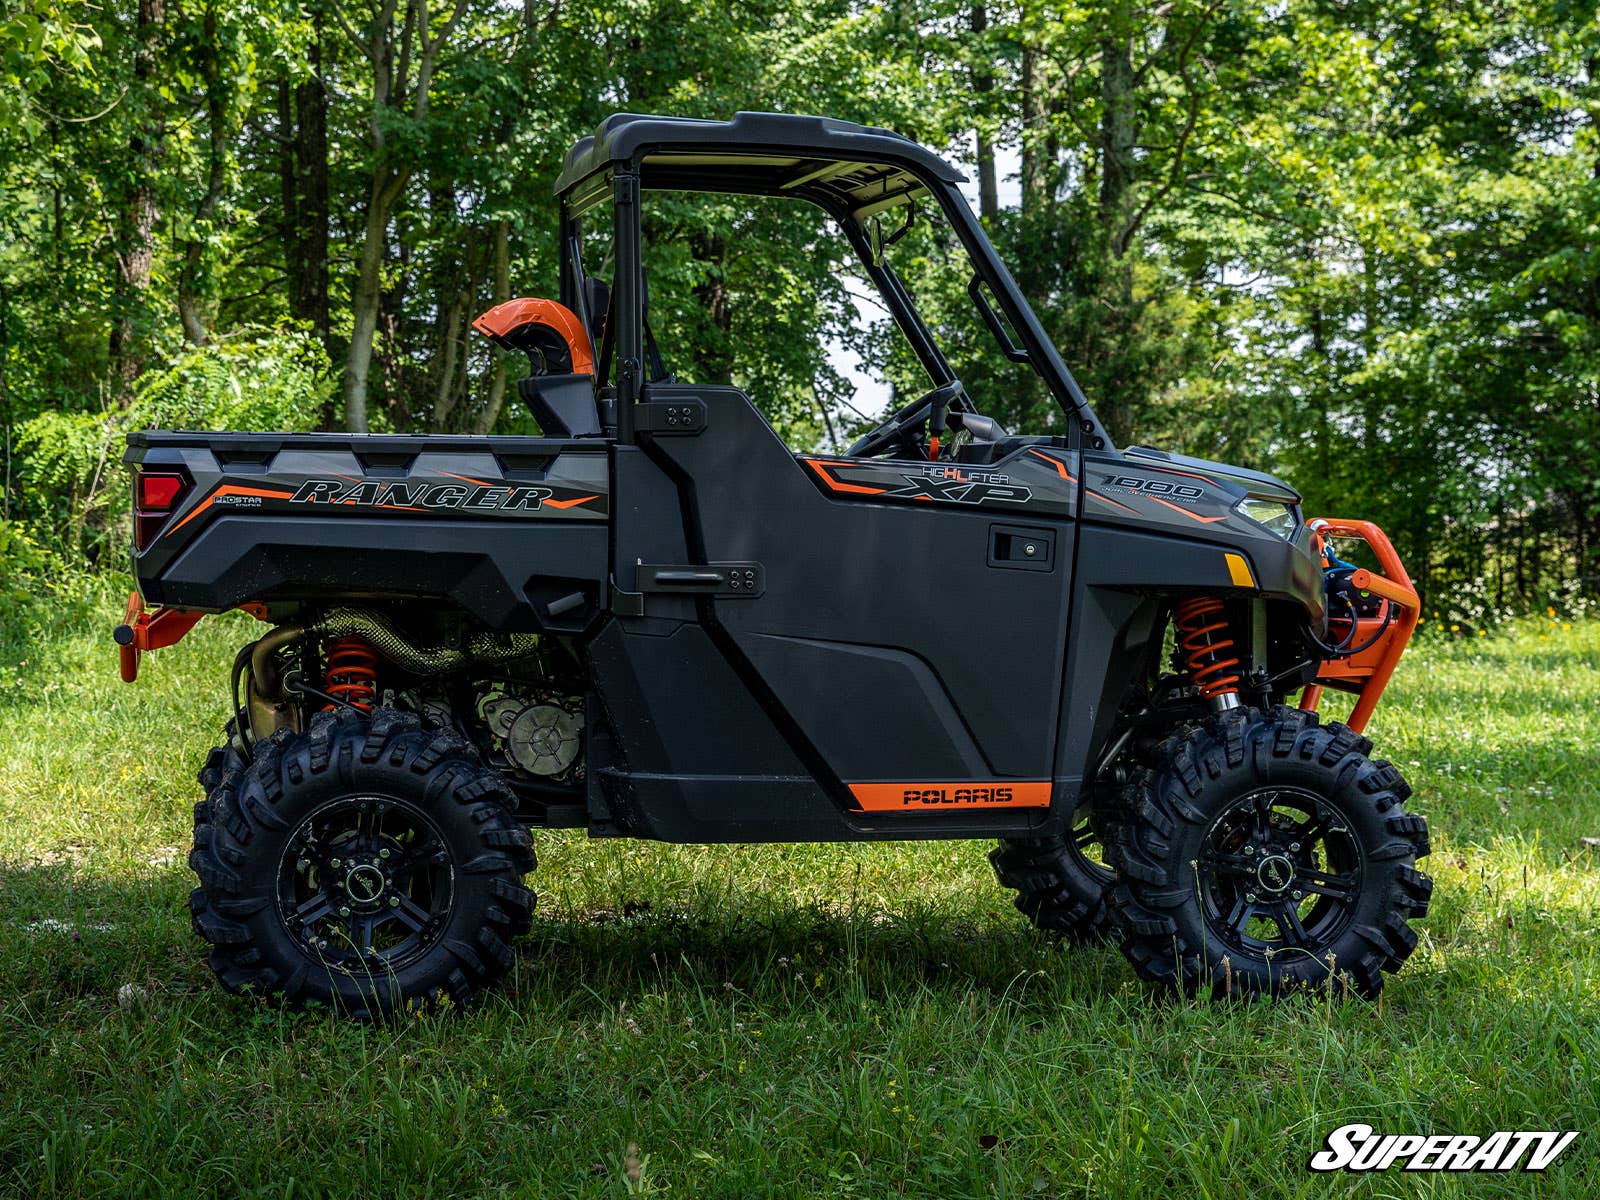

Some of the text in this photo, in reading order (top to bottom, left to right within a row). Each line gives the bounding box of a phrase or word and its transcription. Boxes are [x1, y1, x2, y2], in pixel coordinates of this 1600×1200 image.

[289, 480, 553, 512] RANGER
[887, 474, 1033, 504] XP
[1101, 475, 1204, 499] 1000
[213, 496, 262, 504] PROSTAR
[903, 788, 1013, 805] POLARIS
